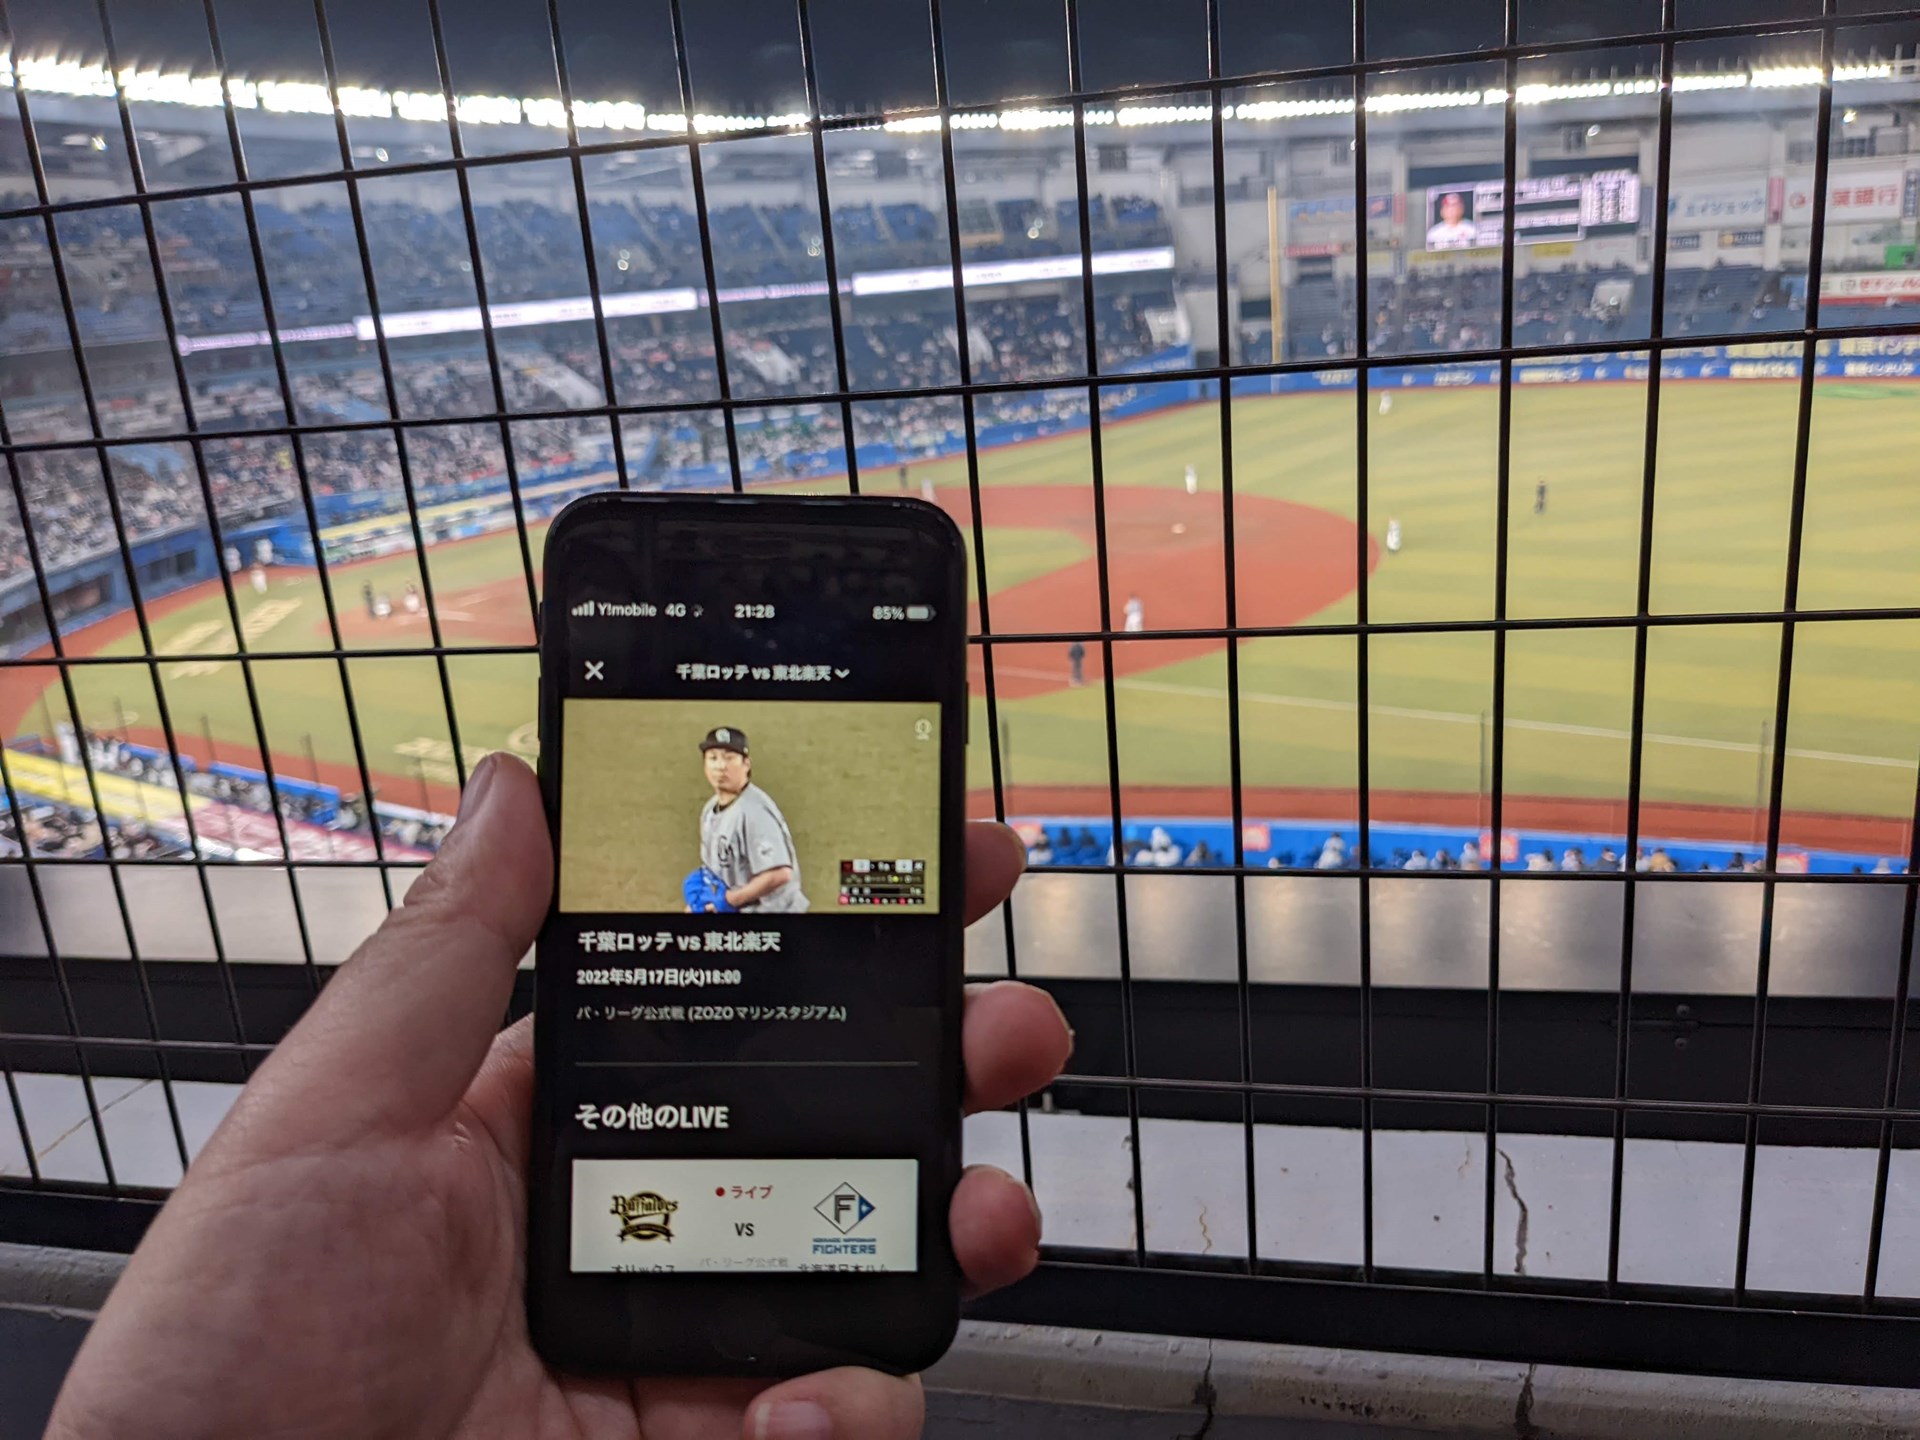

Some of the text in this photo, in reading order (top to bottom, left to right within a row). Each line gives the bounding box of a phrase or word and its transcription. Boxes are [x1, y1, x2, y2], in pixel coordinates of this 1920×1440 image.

[598, 603, 686, 617] Y!mobile 4G
[735, 604, 775, 618] 21:28
[873, 606, 904, 620] 85%
[676, 664, 831, 681] 千葉ロッテ vs 東北楽天
[578, 931, 781, 952] 千葉ロッテ vs 東北楽天
[577, 1006, 684, 1021] パ・リーグ公式戦
[575, 1102, 729, 1130] その他のLIVE
[731, 1186, 773, 1199] ライブ
[735, 1223, 754, 1237] VS
[812, 1244, 876, 1254] FIGHTERS
